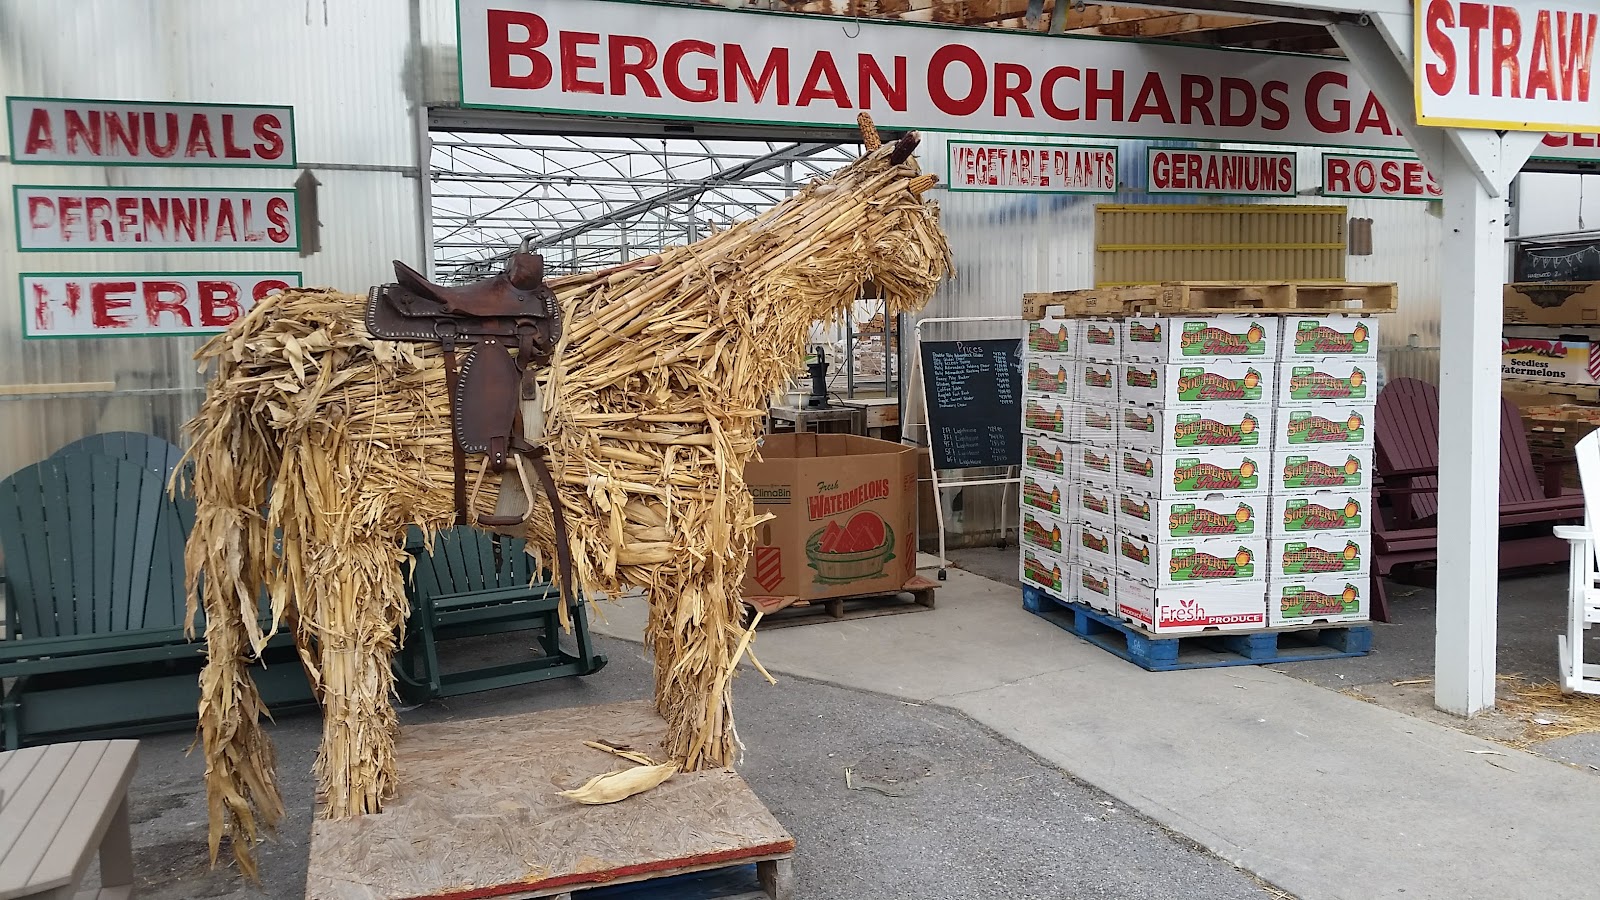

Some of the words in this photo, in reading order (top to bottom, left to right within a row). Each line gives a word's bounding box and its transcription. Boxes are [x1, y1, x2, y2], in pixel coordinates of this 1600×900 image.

[1425, 0, 1598, 102] STRAW
[487, 9, 908, 112] BERGMAN
[927, 43, 1290, 131] ORCHARDS
[24, 108, 284, 160] ANNUALS
[953, 145, 1050, 186] VEGETABLE
[1054, 150, 1115, 189] PLANTS
[1152, 153, 1292, 192] GERANIUMS
[28, 196, 290, 244] PERENNIALS
[1181, 328, 1240, 348] SOUTHERN
[1295, 328, 1347, 346] SOUTHERN
[957, 341, 983, 353] Prices
[1511, 359, 1548, 368] Seedless
[1178, 374, 1237, 393] SOUTHERN
[1290, 373, 1344, 392] SOUTHERN
[1174, 420, 1234, 439] SOUTHERN
[1288, 417, 1341, 436] SOUTHERN
[1174, 464, 1233, 484] SOUTHERN
[1284, 462, 1338, 480] SOUTHERN
[817, 480, 839, 494] Fresh
[808, 478, 889, 521] WATERMELONS
[1169, 510, 1229, 529] SOUTHERN
[1284, 505, 1338, 523] SOUTHERN
[1169, 554, 1229, 573] SOUTHERN
[1282, 548, 1337, 566] SOUTHERN
[1281, 591, 1336, 610] SOUTHERN
[1160, 603, 1206, 622] Fresh
[1208, 614, 1260, 624] PRODUCE
